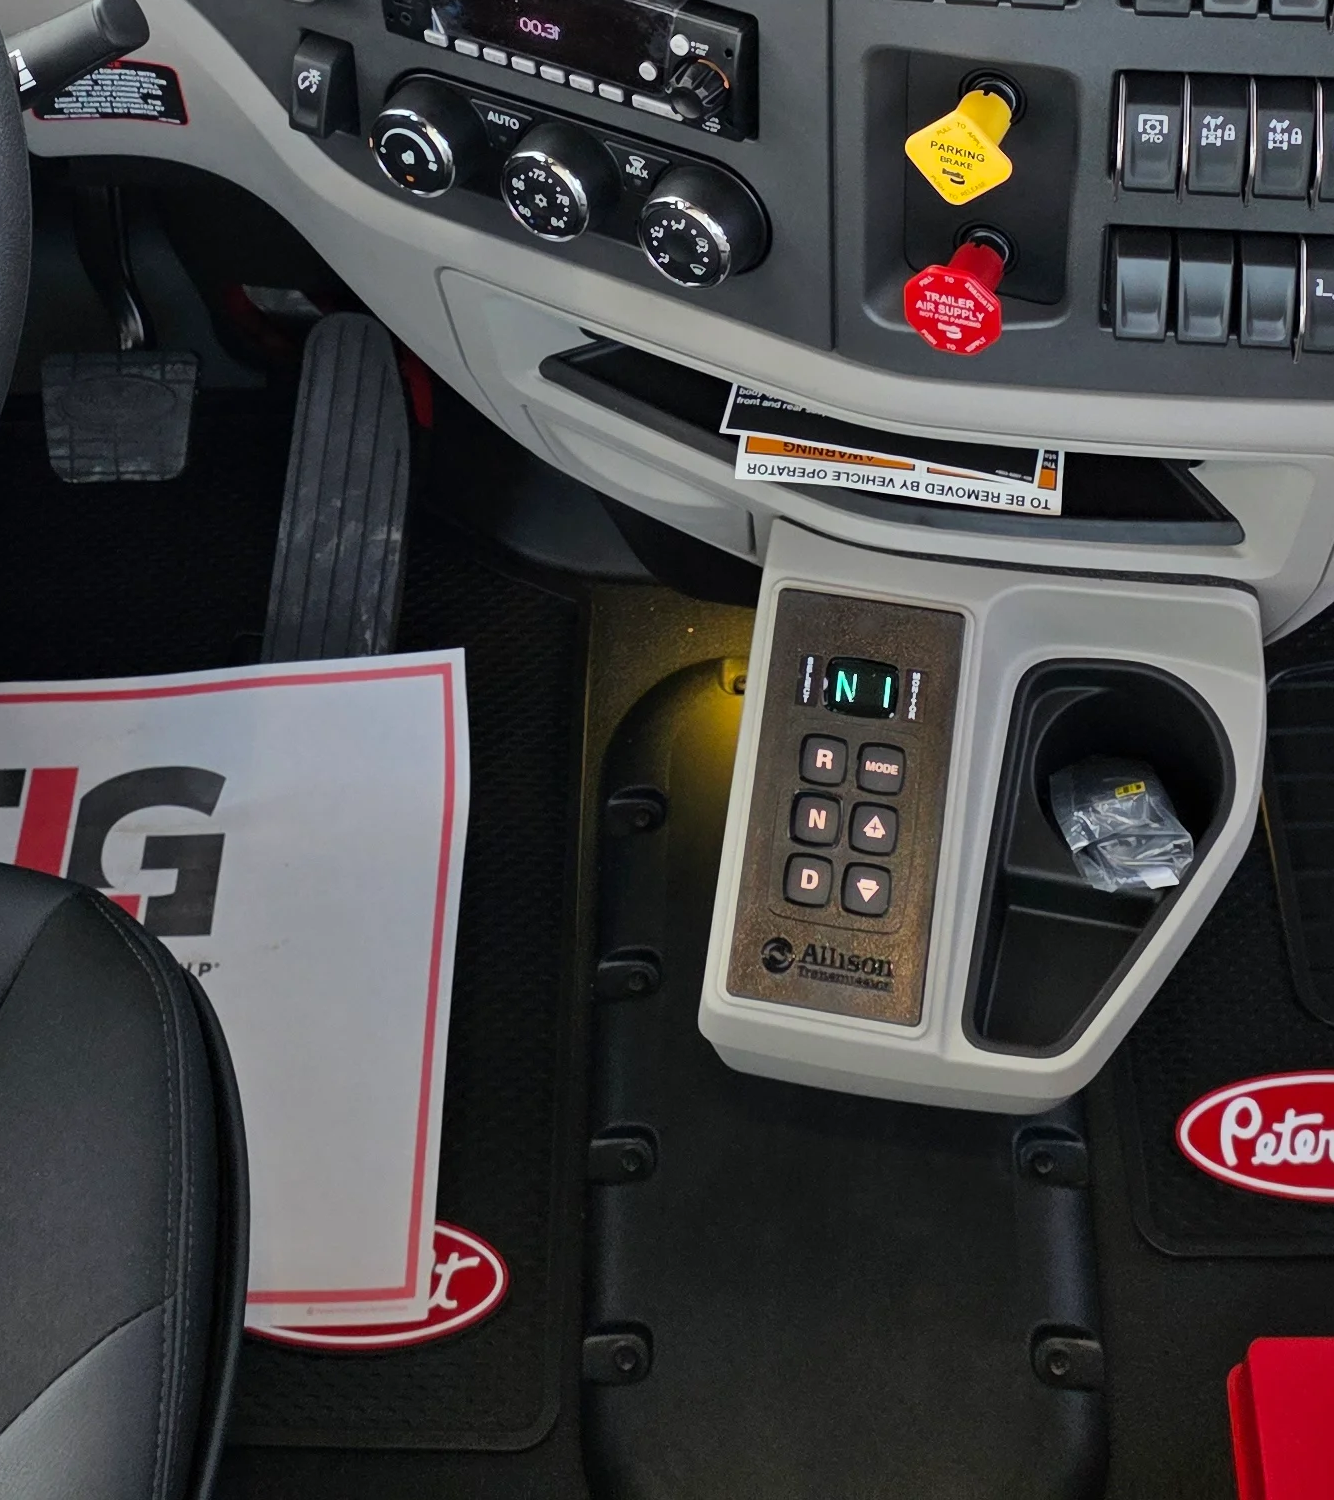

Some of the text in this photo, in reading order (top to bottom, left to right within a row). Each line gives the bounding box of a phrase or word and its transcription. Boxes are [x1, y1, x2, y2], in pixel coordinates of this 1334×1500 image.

[487, 111, 520, 129] AUTO
[1142, 133, 1163, 143] PTO
[930, 140, 985, 162] PARKING
[625, 164, 648, 179] MAX
[940, 155, 973, 170] BRAKE
[533, 168, 546, 181] 72
[960, 181, 985, 196] RELEASE
[945, 276, 954, 284] TO
[924, 290, 974, 310] TRAILER
[915, 300, 985, 322] AIR SUPPLY
[919, 310, 981, 329] NOT FOR PARKING
[737, 396, 761, 406] front
[761, 400, 782, 408] and
[747, 463, 1051, 510] TO BE REMOVED BY VEHICLE OPERATOR
[803, 657, 814, 703] SELECT
[835, 671, 857, 702] N
[907, 672, 921, 720] MONITOR
[815, 748, 834, 770] R
[865, 760, 899, 776] MODE
[808, 808, 827, 830] N
[800, 868, 819, 890] D
[799, 943, 893, 977] Allison
